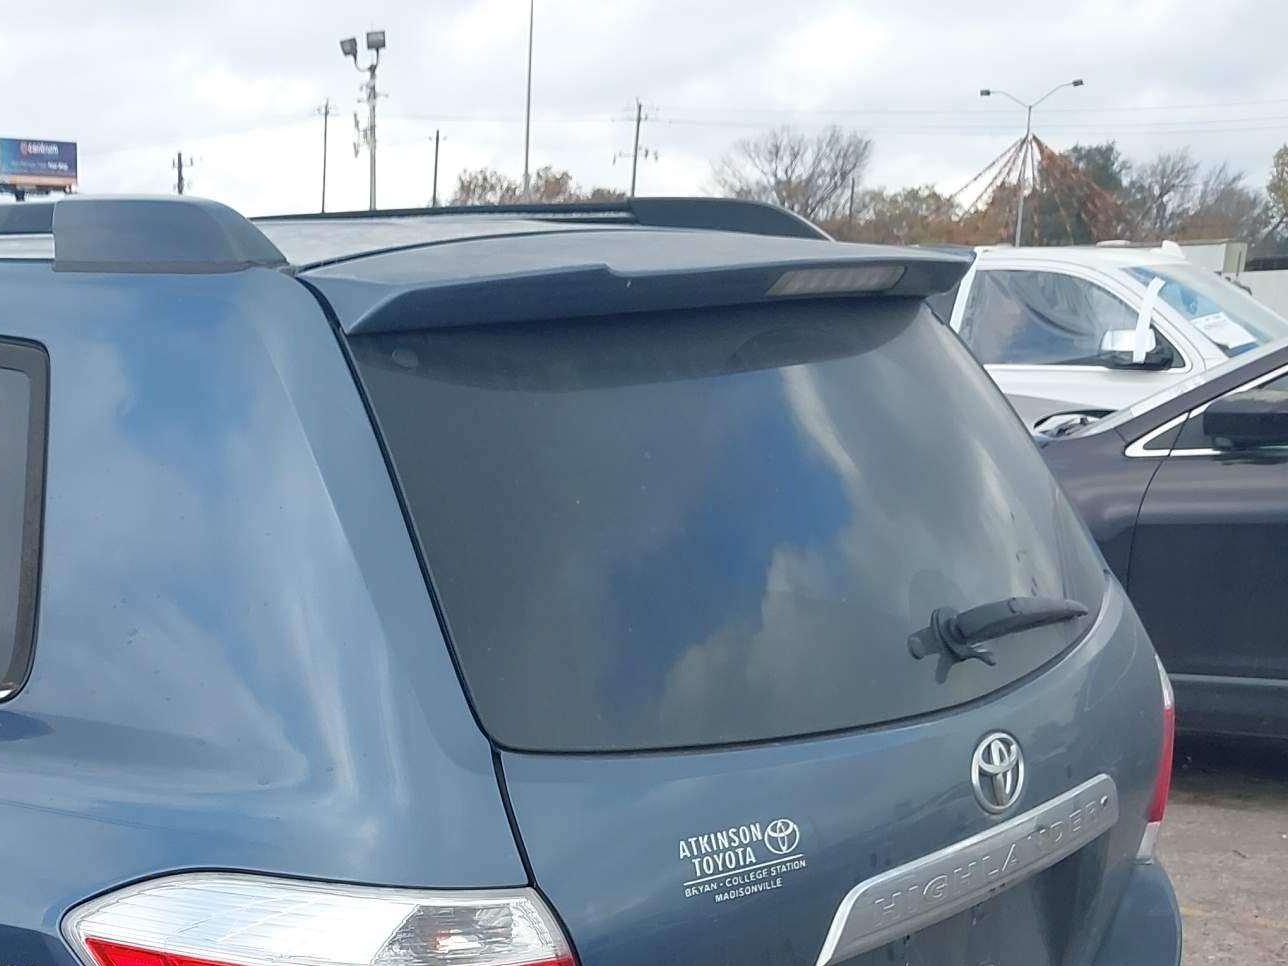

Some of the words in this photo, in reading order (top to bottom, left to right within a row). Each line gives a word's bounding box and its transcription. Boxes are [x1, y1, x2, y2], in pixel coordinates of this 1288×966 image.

[678, 822, 763, 860] ATKINSON
[684, 882, 718, 898] BRYAN
[725, 868, 769, 888] COLLEGE
[770, 859, 807, 877] STATION
[691, 846, 757, 877] TOYOTA
[714, 877, 784, 903] MADISONVILLE
